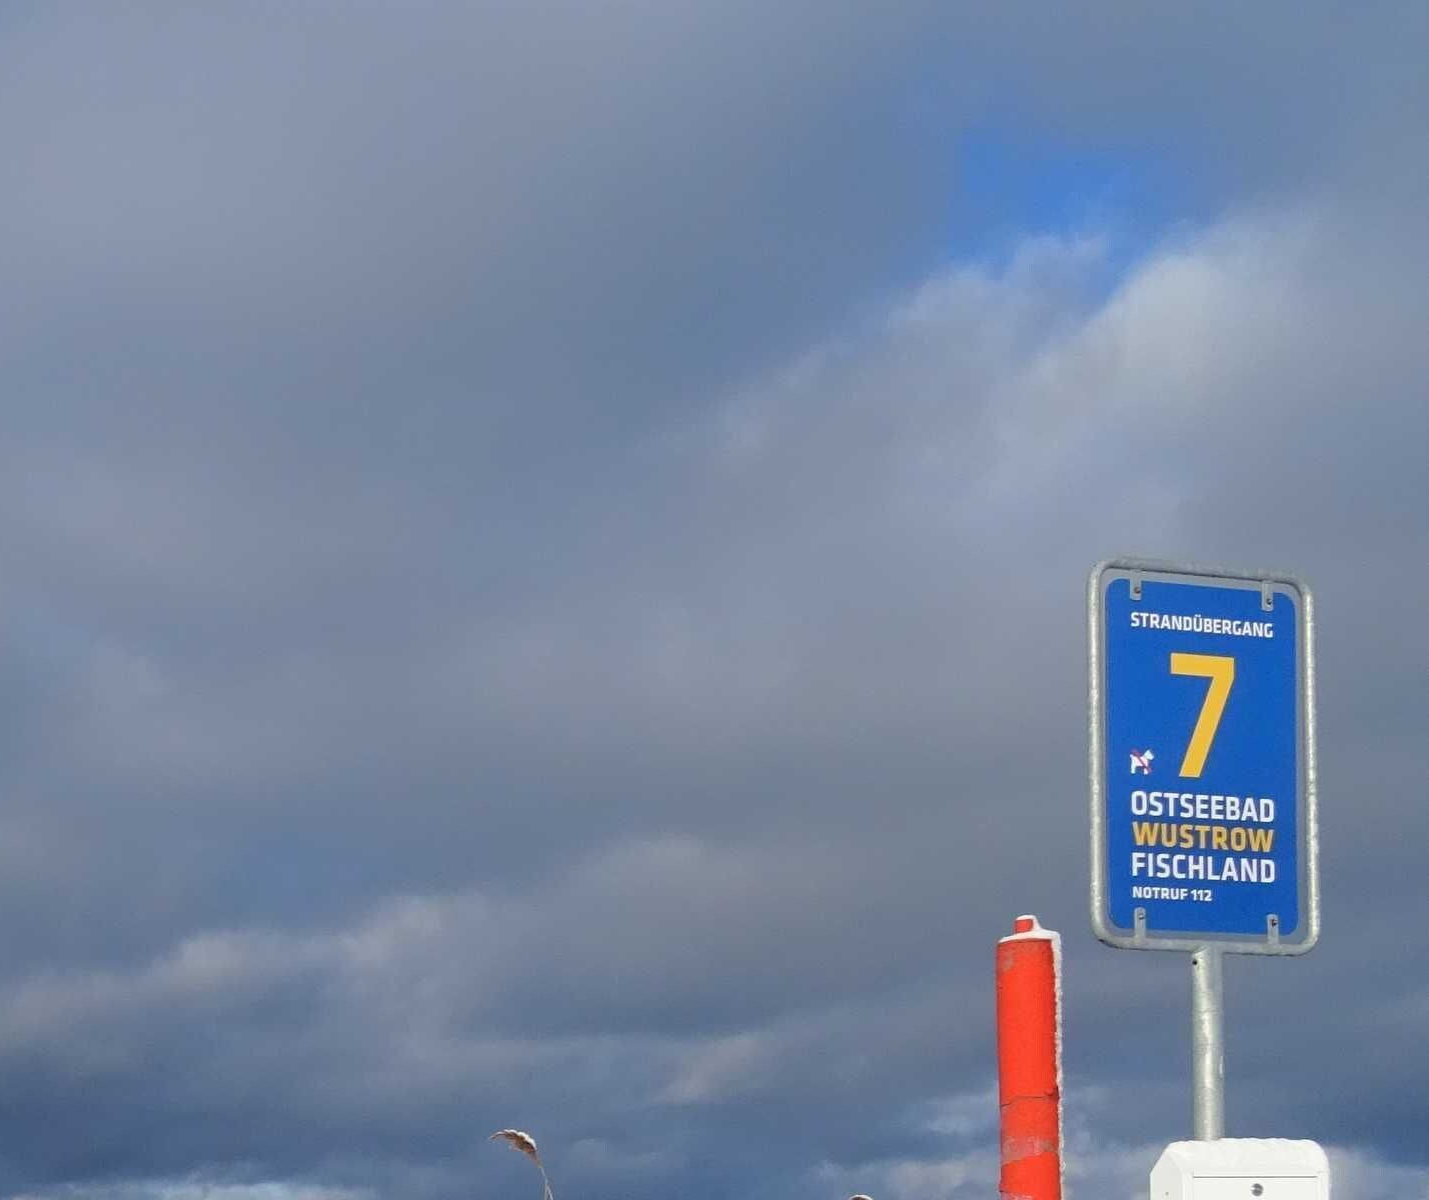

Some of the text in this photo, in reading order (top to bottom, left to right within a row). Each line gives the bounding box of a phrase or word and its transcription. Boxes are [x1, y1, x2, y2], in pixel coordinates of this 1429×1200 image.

[1130, 611, 1274, 638] STRANDÜBERGANG
[1170, 652, 1235, 778] 7
[1131, 790, 1274, 823] OSTSEEBAD
[1132, 821, 1274, 852] WUSTROW
[1131, 851, 1275, 883] FISCHLAND
[1132, 886, 1213, 902] NOTRUF 112
